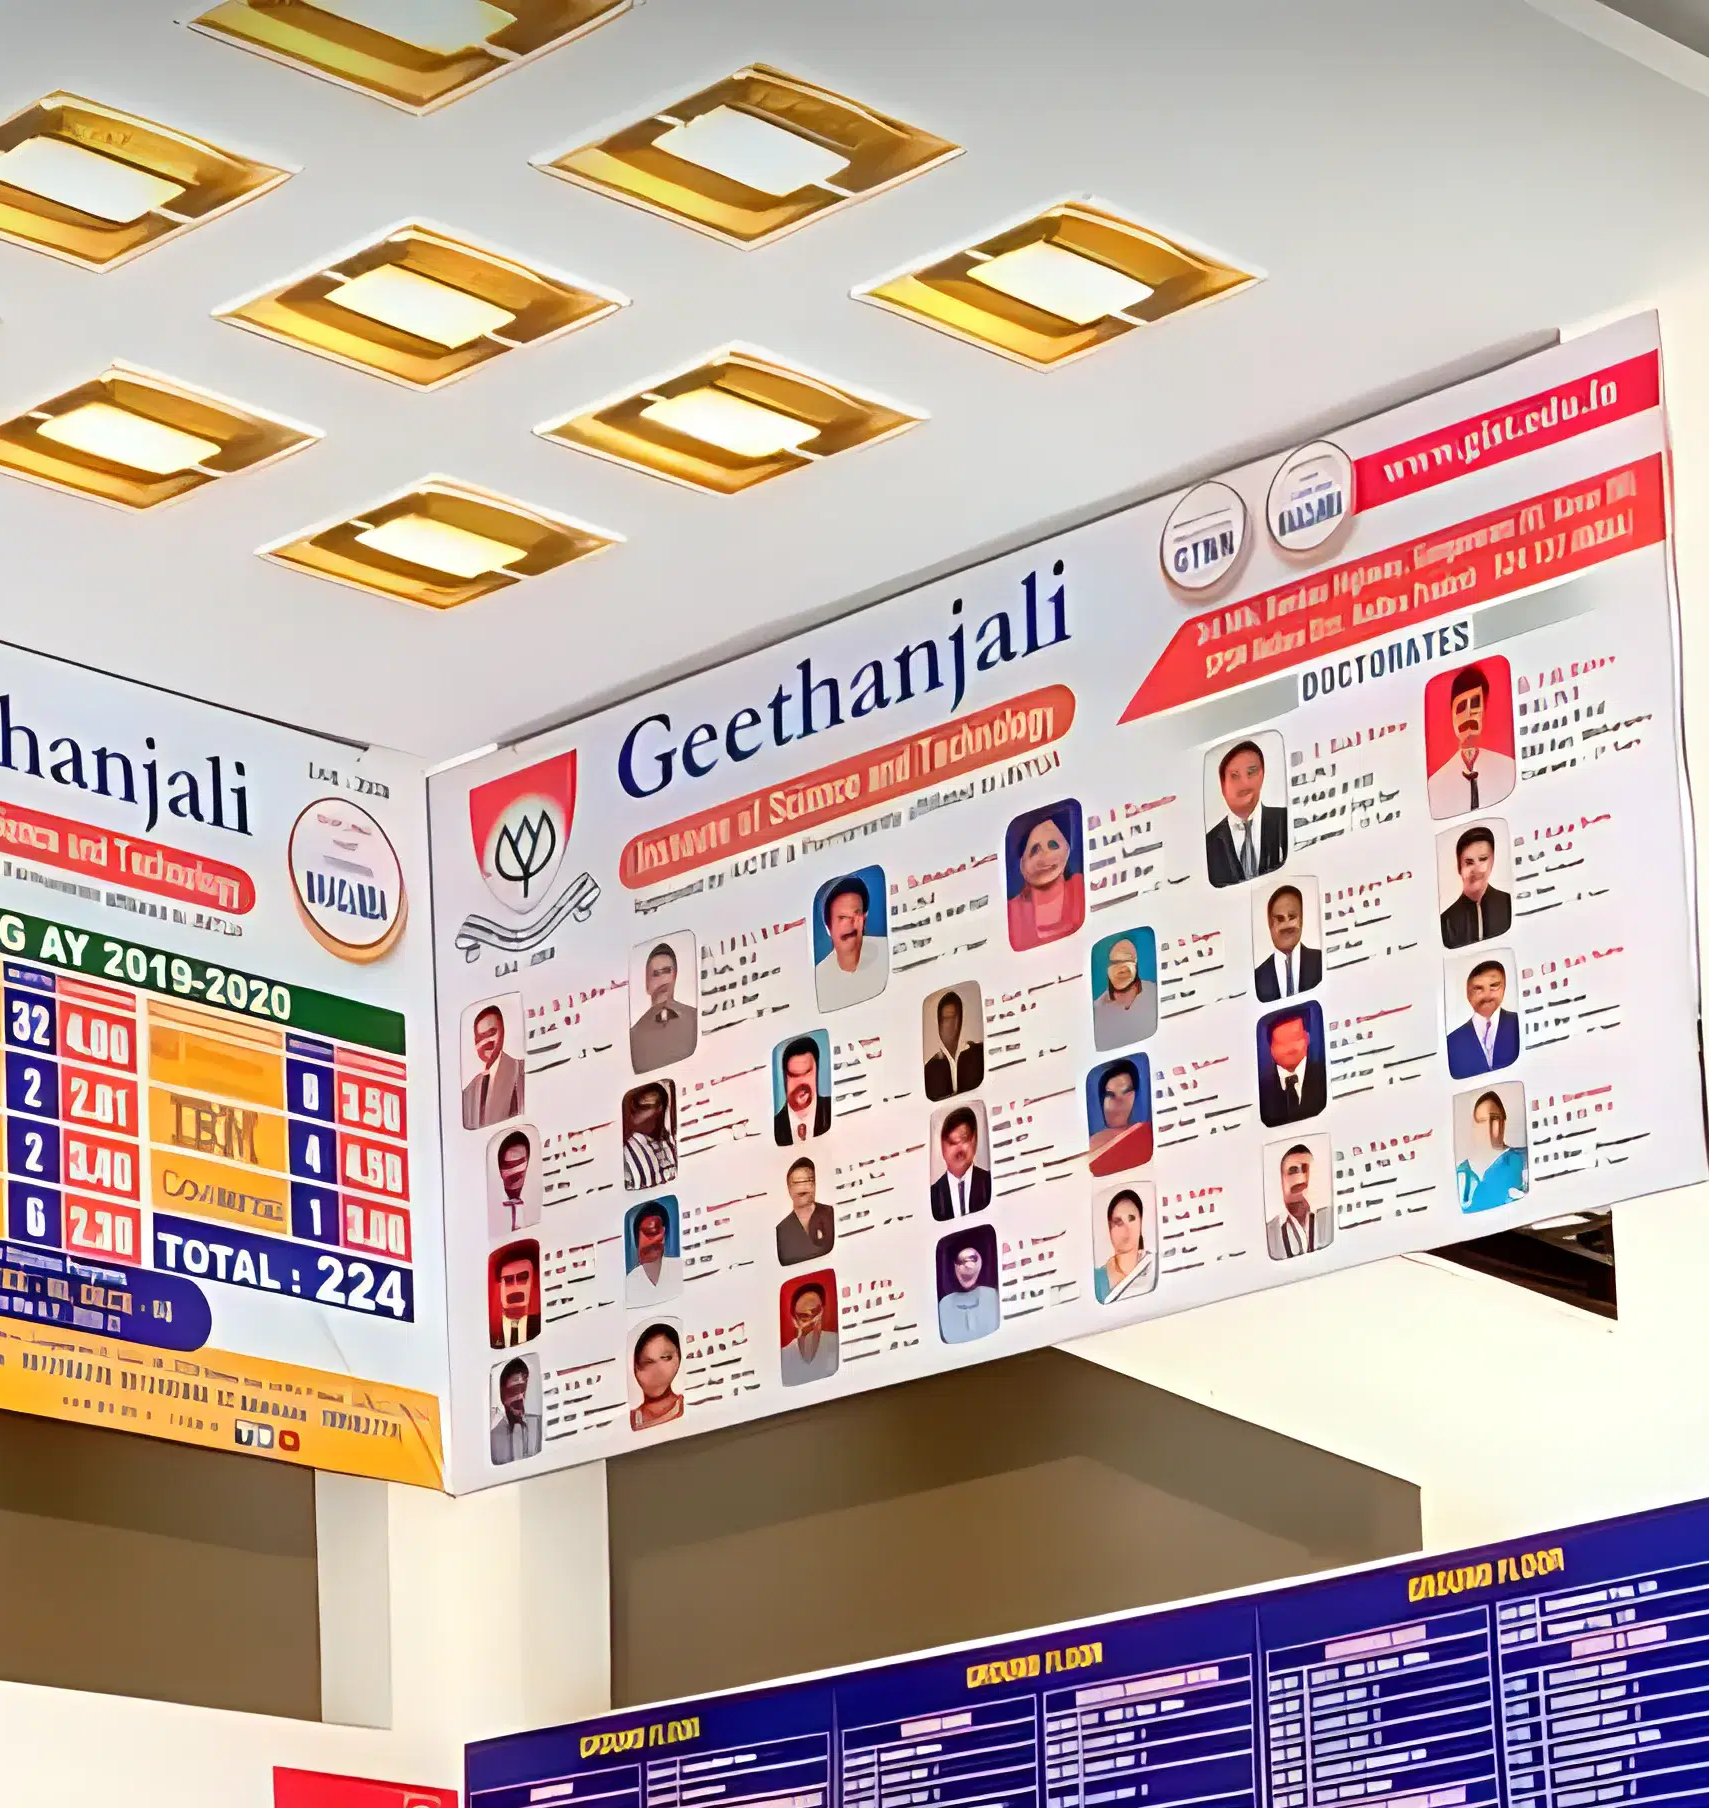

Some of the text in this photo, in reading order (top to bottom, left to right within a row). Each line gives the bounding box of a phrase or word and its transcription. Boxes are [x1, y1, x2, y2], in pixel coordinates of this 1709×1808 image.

[617, 558, 1072, 799] Geethanjali
[1302, 620, 1471, 702] DOCTORATES
[40, 921, 91, 968] AY
[105, 942, 292, 1021] 2019-2020
[12, 1000, 50, 1046] 32
[23, 1068, 42, 1108] 2
[25, 1132, 44, 1172] 2
[306, 1134, 321, 1173] 4
[310, 1199, 322, 1236] 1
[157, 1232, 280, 1291] TOTAL
[316, 1255, 406, 1316] 224
